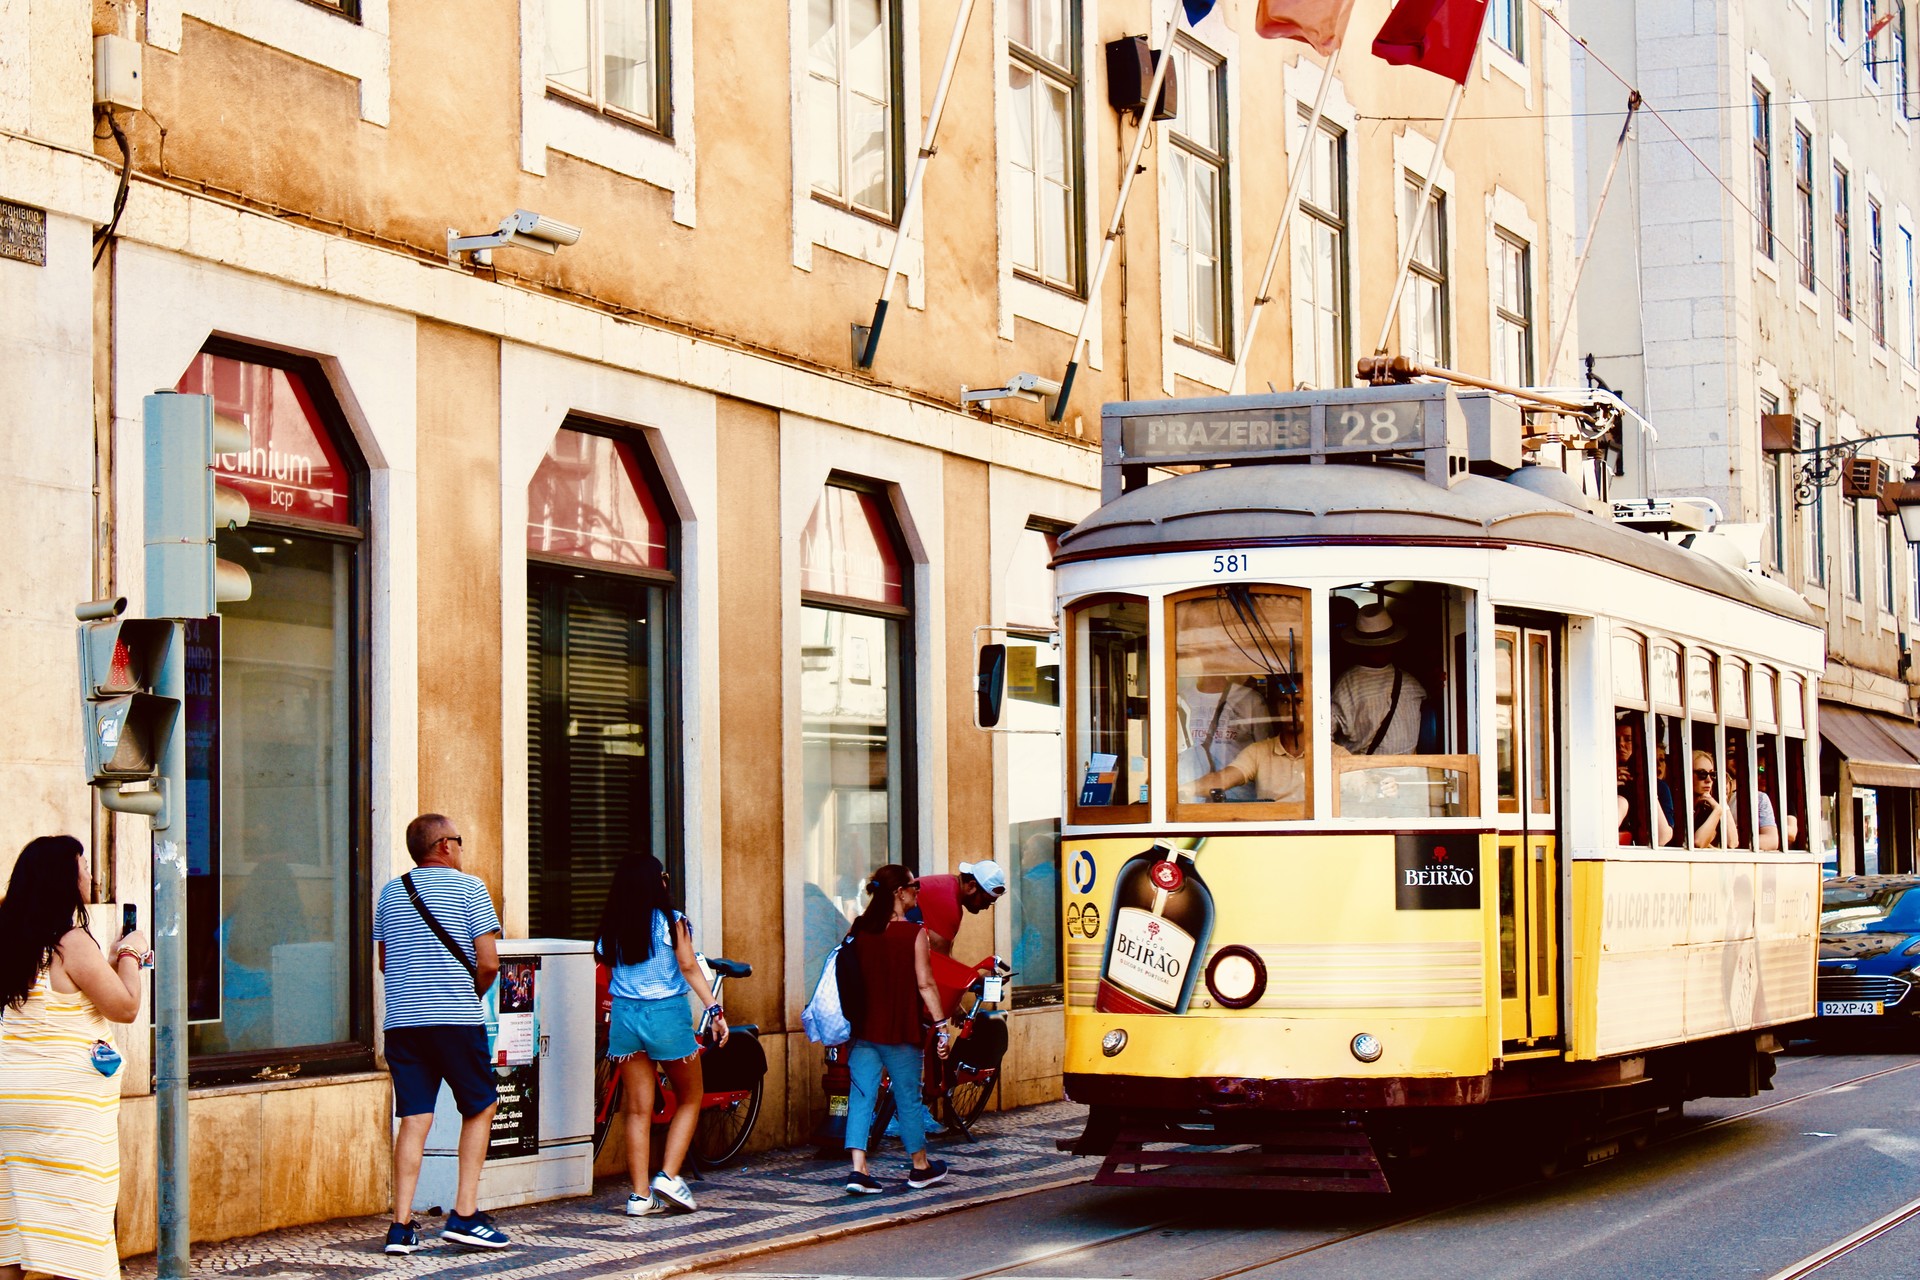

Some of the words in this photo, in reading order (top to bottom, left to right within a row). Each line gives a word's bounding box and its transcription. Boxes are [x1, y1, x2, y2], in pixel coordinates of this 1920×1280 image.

[0, 204, 39, 223] ROHIBIDO
[1148, 420, 1309, 447] PRAZERES
[1339, 408, 1399, 447] 28
[270, 484, 294, 511] bcp
[1213, 554, 1247, 574] 581
[1083, 791, 1094, 803] 11
[1404, 868, 1474, 886] BEIRÃO
[1616, 892, 1650, 929] LICOR
[1652, 892, 1666, 928] DE
[1668, 892, 1718, 928] PORTUGAL
[1136, 935, 1165, 952] LICOR
[1117, 933, 1180, 978] BEIRÃO
